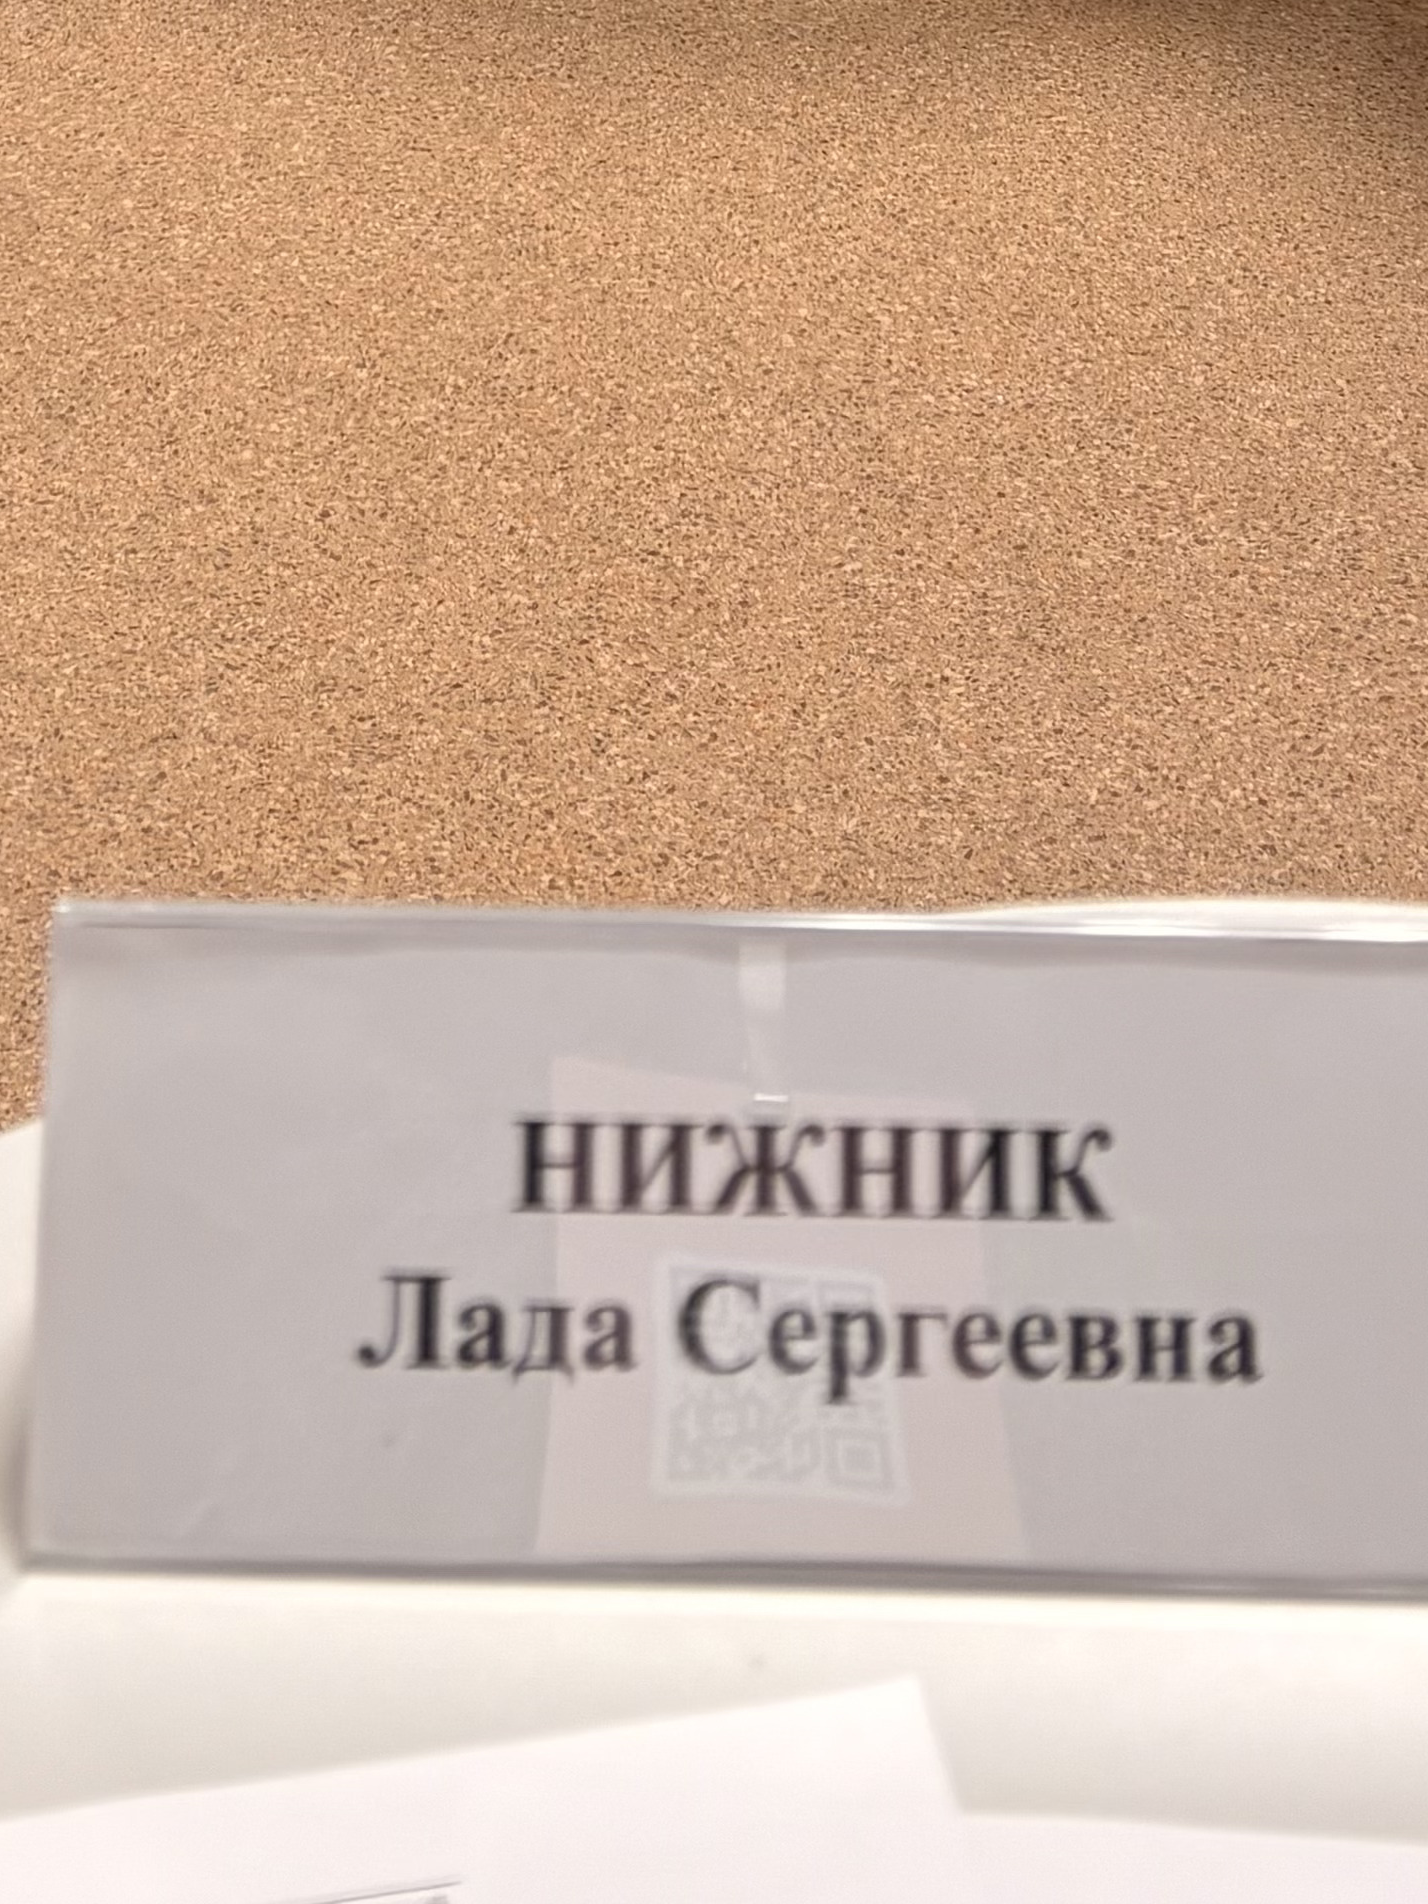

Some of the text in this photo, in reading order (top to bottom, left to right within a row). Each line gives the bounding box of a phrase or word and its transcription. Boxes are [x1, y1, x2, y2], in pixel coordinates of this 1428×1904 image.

[513, 1114, 1115, 1224] НИЖНИК
[355, 1272, 1264, 1406] Лада Сергеевна
